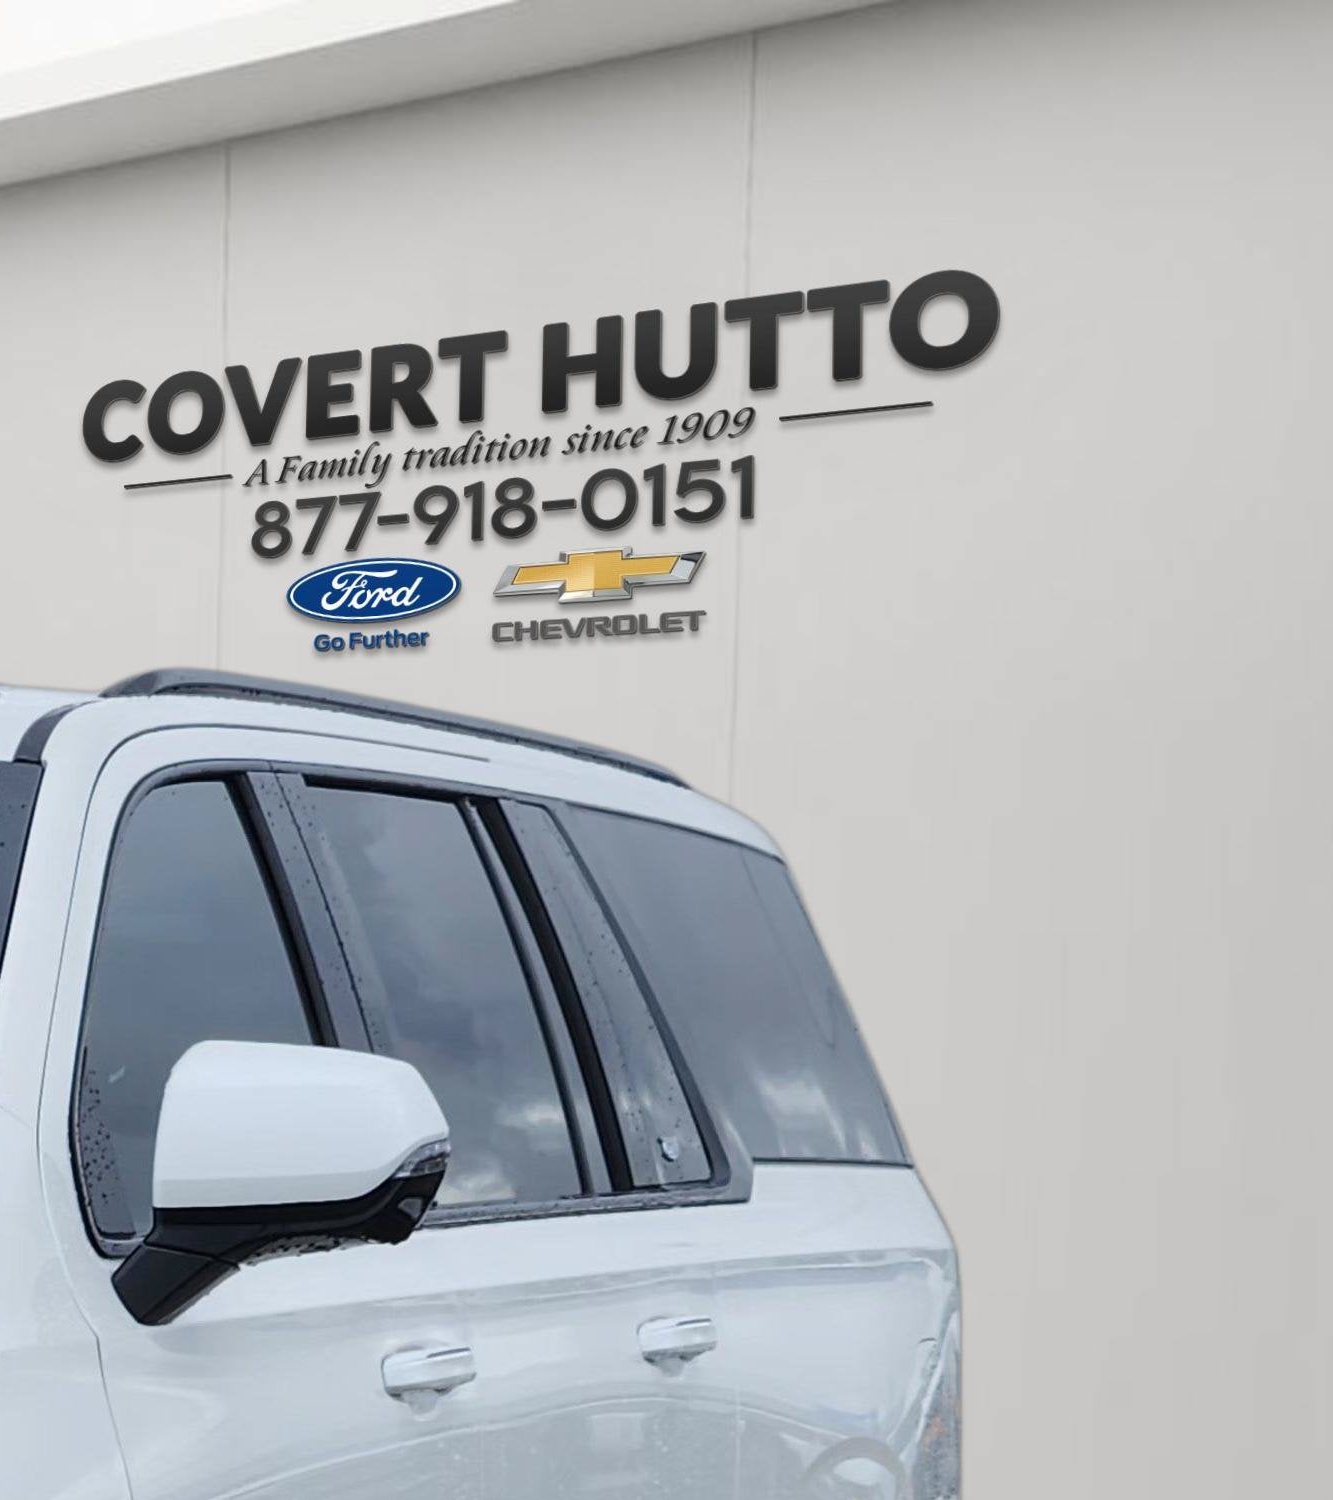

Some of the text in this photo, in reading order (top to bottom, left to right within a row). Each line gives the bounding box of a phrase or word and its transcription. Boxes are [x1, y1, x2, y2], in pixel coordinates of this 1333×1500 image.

[82, 269, 1001, 464] COVERT HUTTO
[243, 407, 756, 488] A Family tradition since 1909
[250, 455, 756, 558] 877-918-0151
[321, 569, 421, 611] Ford
[313, 628, 430, 652] Go Further
[492, 610, 707, 643] CHEVROLET
